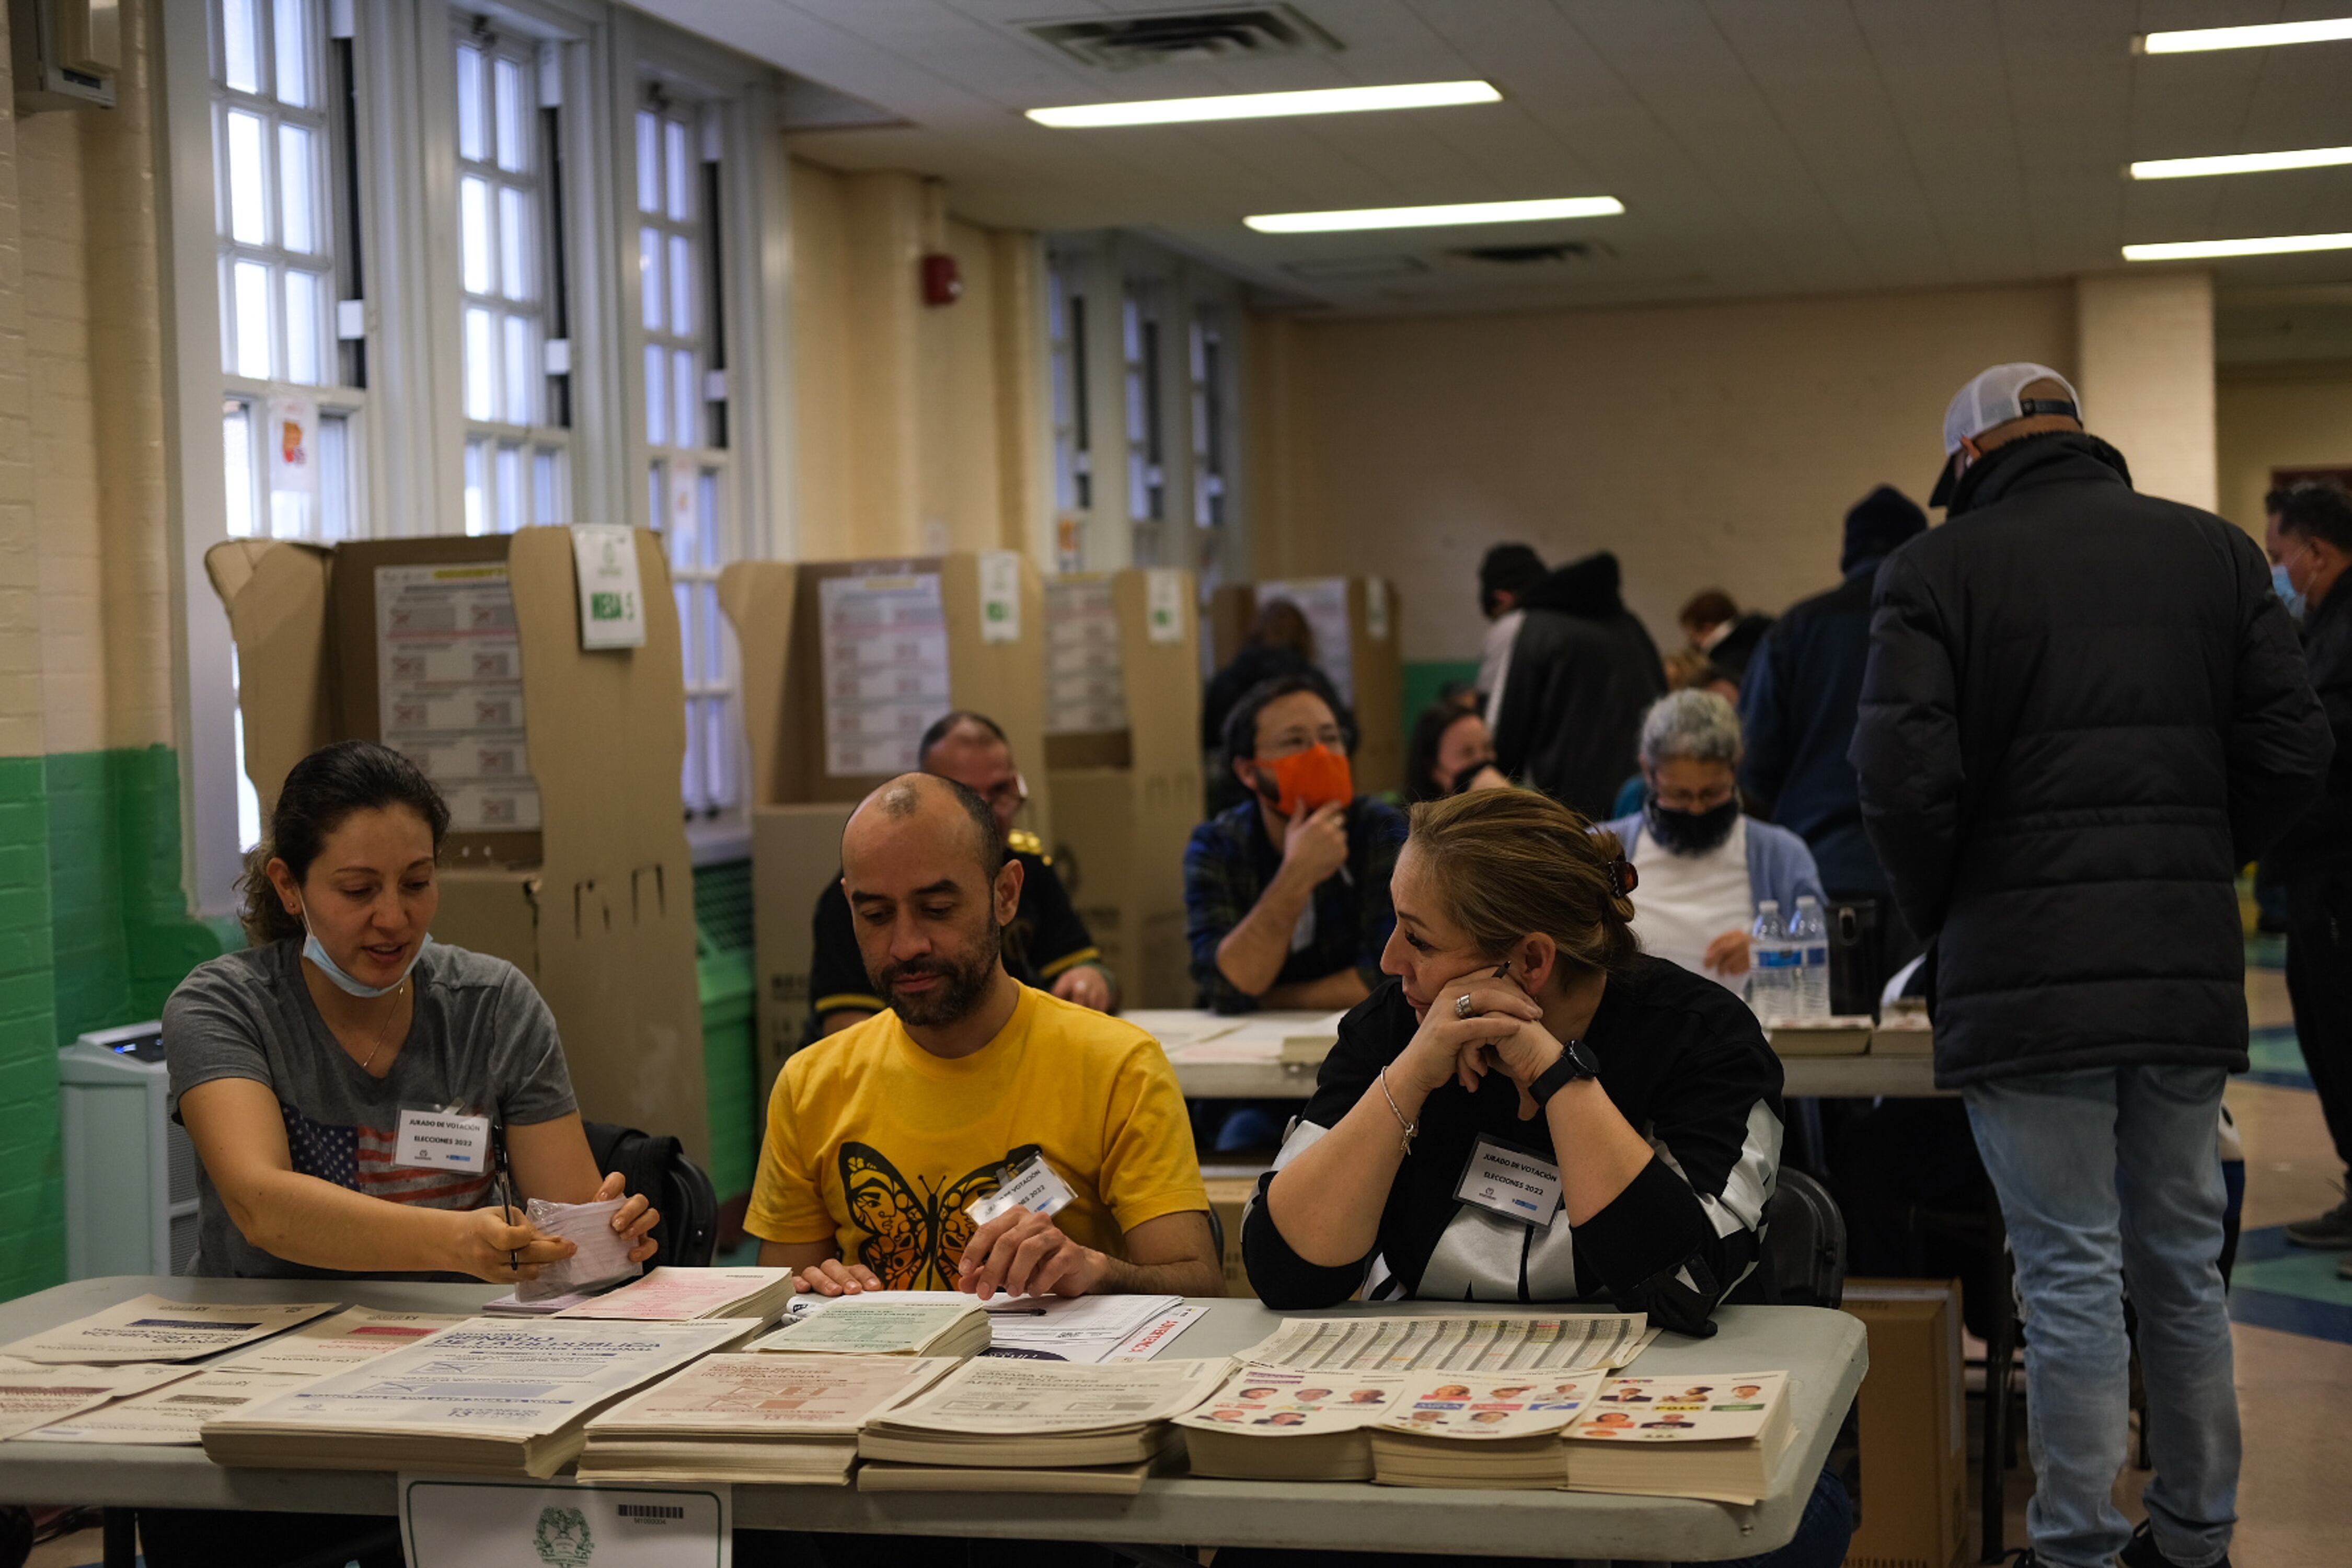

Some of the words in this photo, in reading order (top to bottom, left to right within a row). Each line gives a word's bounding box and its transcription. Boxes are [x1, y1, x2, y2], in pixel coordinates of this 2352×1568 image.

[409, 1119, 436, 1128] JURADO
[446, 1122, 481, 1132] VOTACIÓN
[414, 1136, 453, 1145] ELECCIONES
[1483, 1154, 1511, 1167] JURADO
[1511, 1161, 1520, 1169] DE
[1521, 1164, 1558, 1183] VOTACIÓN
[1011, 1169, 1042, 1194] VOTACIÓN
[1029, 1184, 1046, 1199] 2022
[1484, 1171, 1524, 1189] ELECCIONES
[1524, 1183, 1544, 1196] 2022
